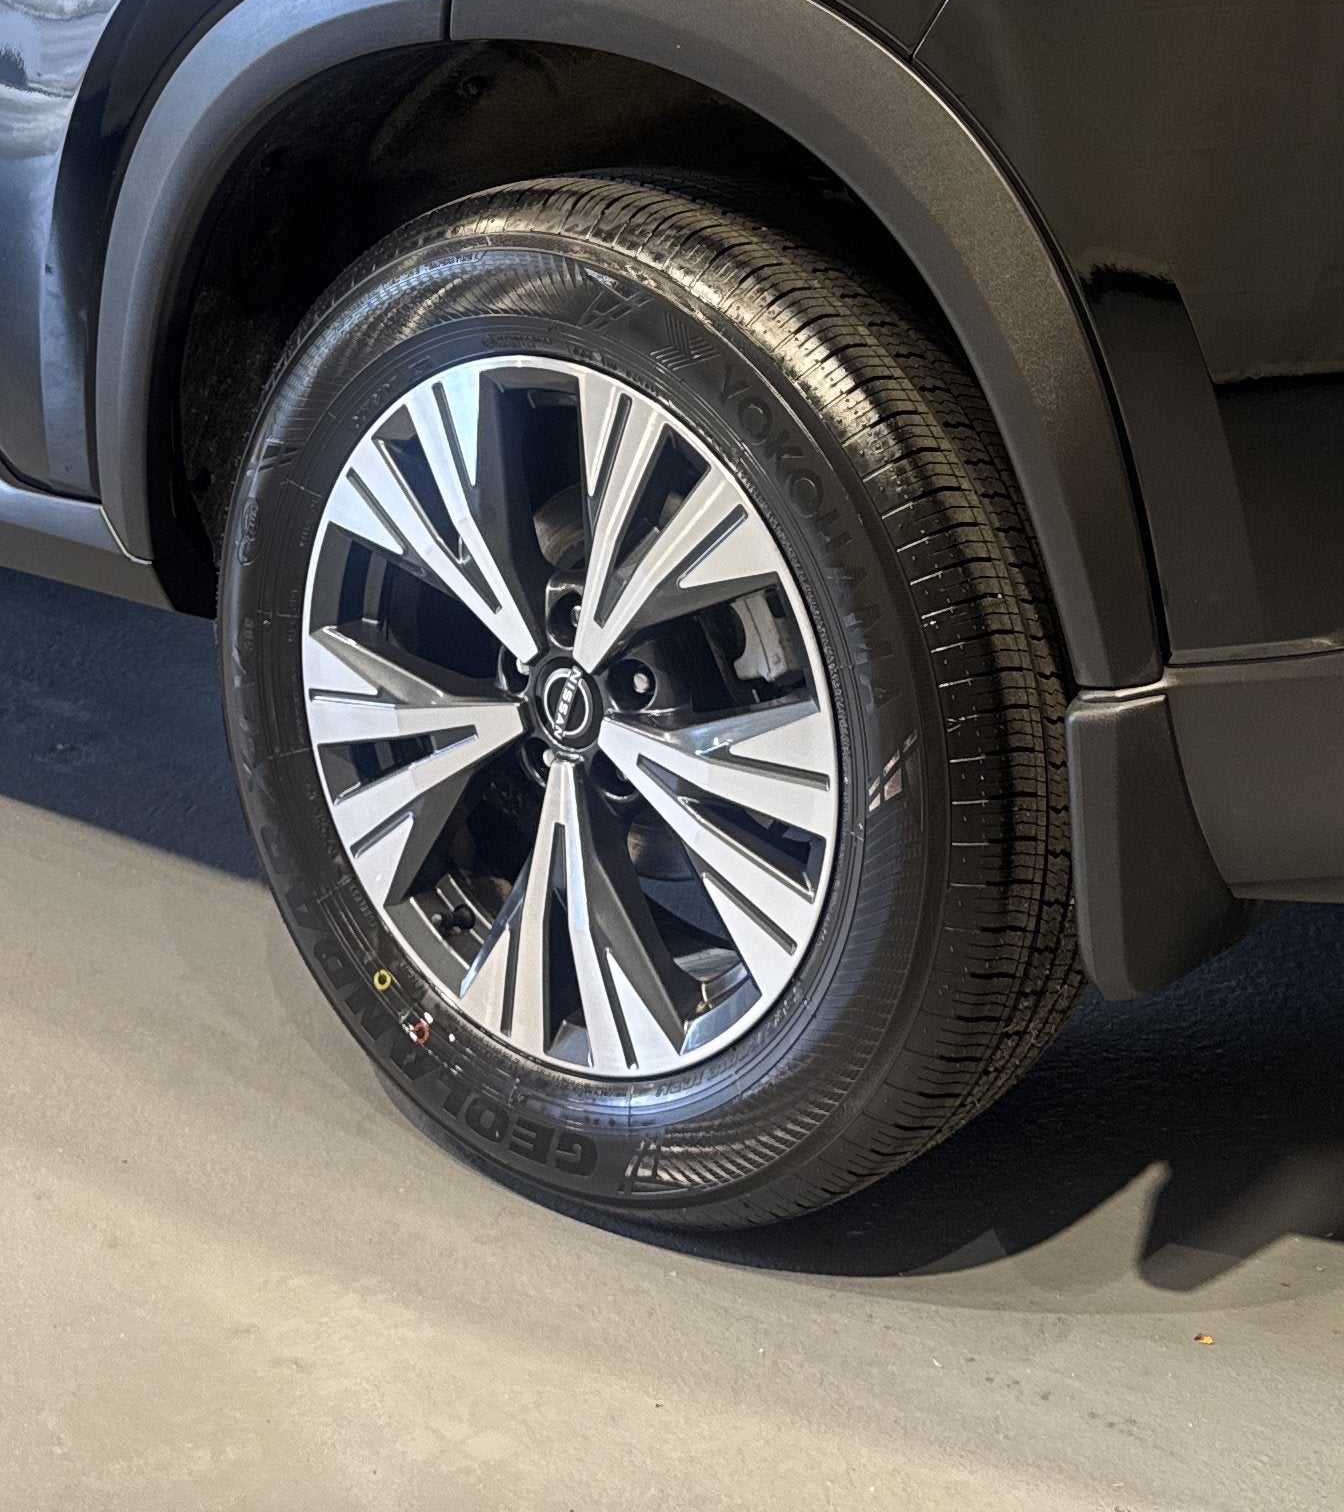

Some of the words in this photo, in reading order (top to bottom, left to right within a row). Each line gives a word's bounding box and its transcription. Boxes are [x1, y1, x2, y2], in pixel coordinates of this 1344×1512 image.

[553, 665, 583, 740] NISSAN
[716, 368, 902, 716] YOKOHAMA
[260, 824, 598, 1177] GEOLANDAR
